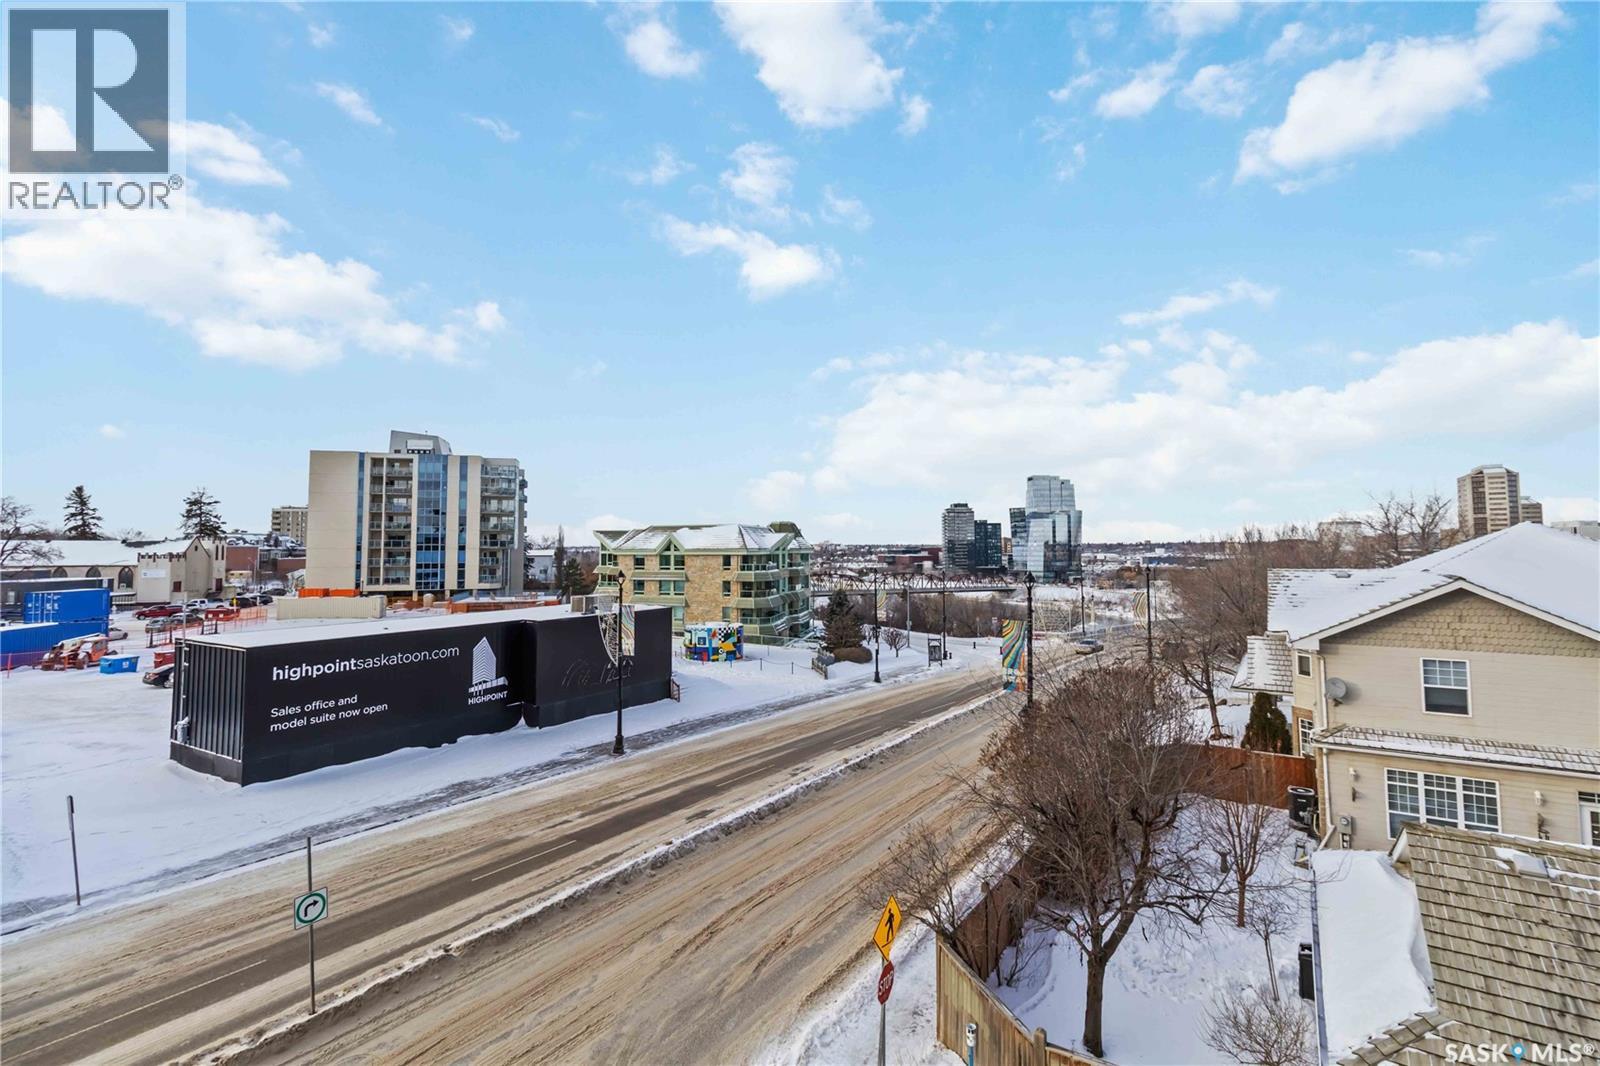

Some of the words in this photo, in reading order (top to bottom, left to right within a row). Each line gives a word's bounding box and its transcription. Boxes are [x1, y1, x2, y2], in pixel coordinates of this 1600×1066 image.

[273, 646, 459, 681] highpointsaskatoon.com
[270, 706, 302, 718] Sales
[304, 699, 335, 712] office
[337, 694, 358, 706] and
[468, 690, 508, 705] HIGHPOINT
[270, 716, 307, 732] model
[310, 712, 336, 725] suite
[338, 708, 361, 719] now
[363, 703, 388, 715] open
[879, 970, 894, 995] STOP
